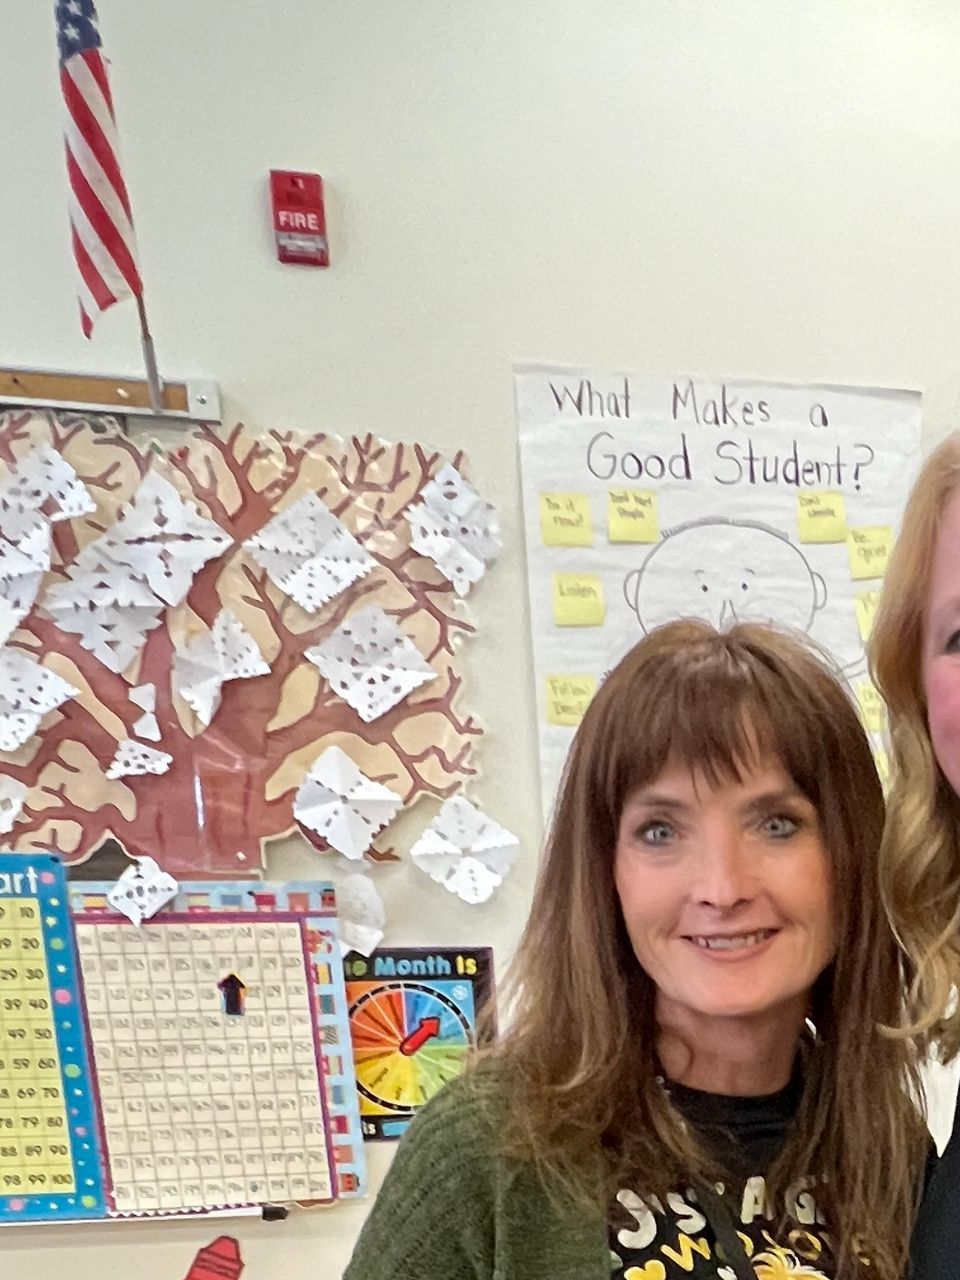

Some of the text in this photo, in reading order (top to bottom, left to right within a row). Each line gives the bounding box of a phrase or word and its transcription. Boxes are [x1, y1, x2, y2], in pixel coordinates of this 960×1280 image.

[278, 210, 320, 231] FIRE
[549, 377, 830, 428] What Makes a
[586, 431, 875, 492] Good Student?
[0, 866, 38, 894] art
[20, 906, 35, 919] 10
[21, 937, 40, 950] 20
[374, 955, 452, 977] Month
[455, 954, 478, 976] Is
[26, 968, 44, 980] 30
[4, 998, 48, 1010] 39 40
[7, 1028, 52, 1040] 49 50
[12, 1057, 30, 1069] 59
[38, 1057, 56, 1069] 60
[17, 1087, 36, 1099] 69
[41, 1087, 59, 1099] 70
[21, 1116, 39, 1128] 79
[47, 1116, 63, 1127] 80
[25, 1145, 42, 1157] 89
[50, 1145, 68, 1156] 90
[3, 1173, 72, 1186] 98 99 100
